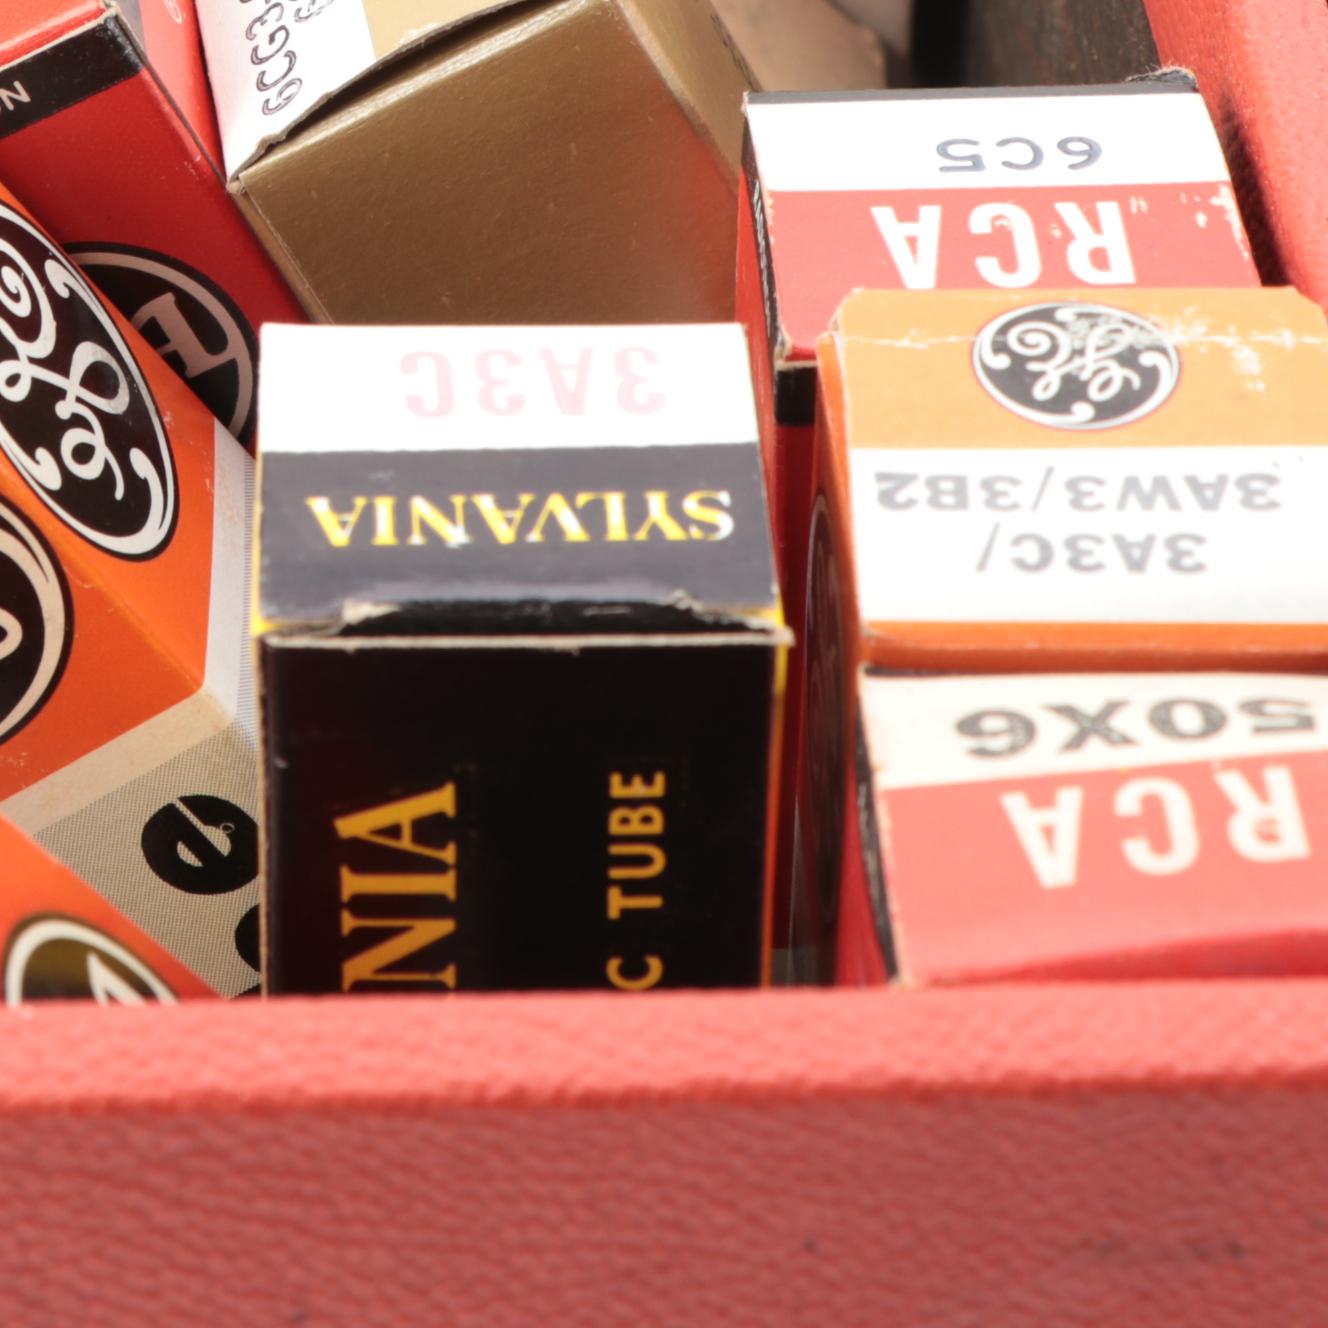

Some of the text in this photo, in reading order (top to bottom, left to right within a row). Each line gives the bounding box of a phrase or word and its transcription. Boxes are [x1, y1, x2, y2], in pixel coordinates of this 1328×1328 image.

[936, 136, 1103, 173] 6C5
[870, 200, 1137, 290] RCA
[399, 345, 668, 420] 3A3C
[305, 489, 735, 549] SYLVANIA
[876, 466, 1284, 512] 3AW3/3B2
[976, 522, 1208, 574] 3A3C/
[954, 697, 1317, 761] 50X6
[606, 770, 667, 919] TUBE
[999, 766, 1312, 890] RCA
